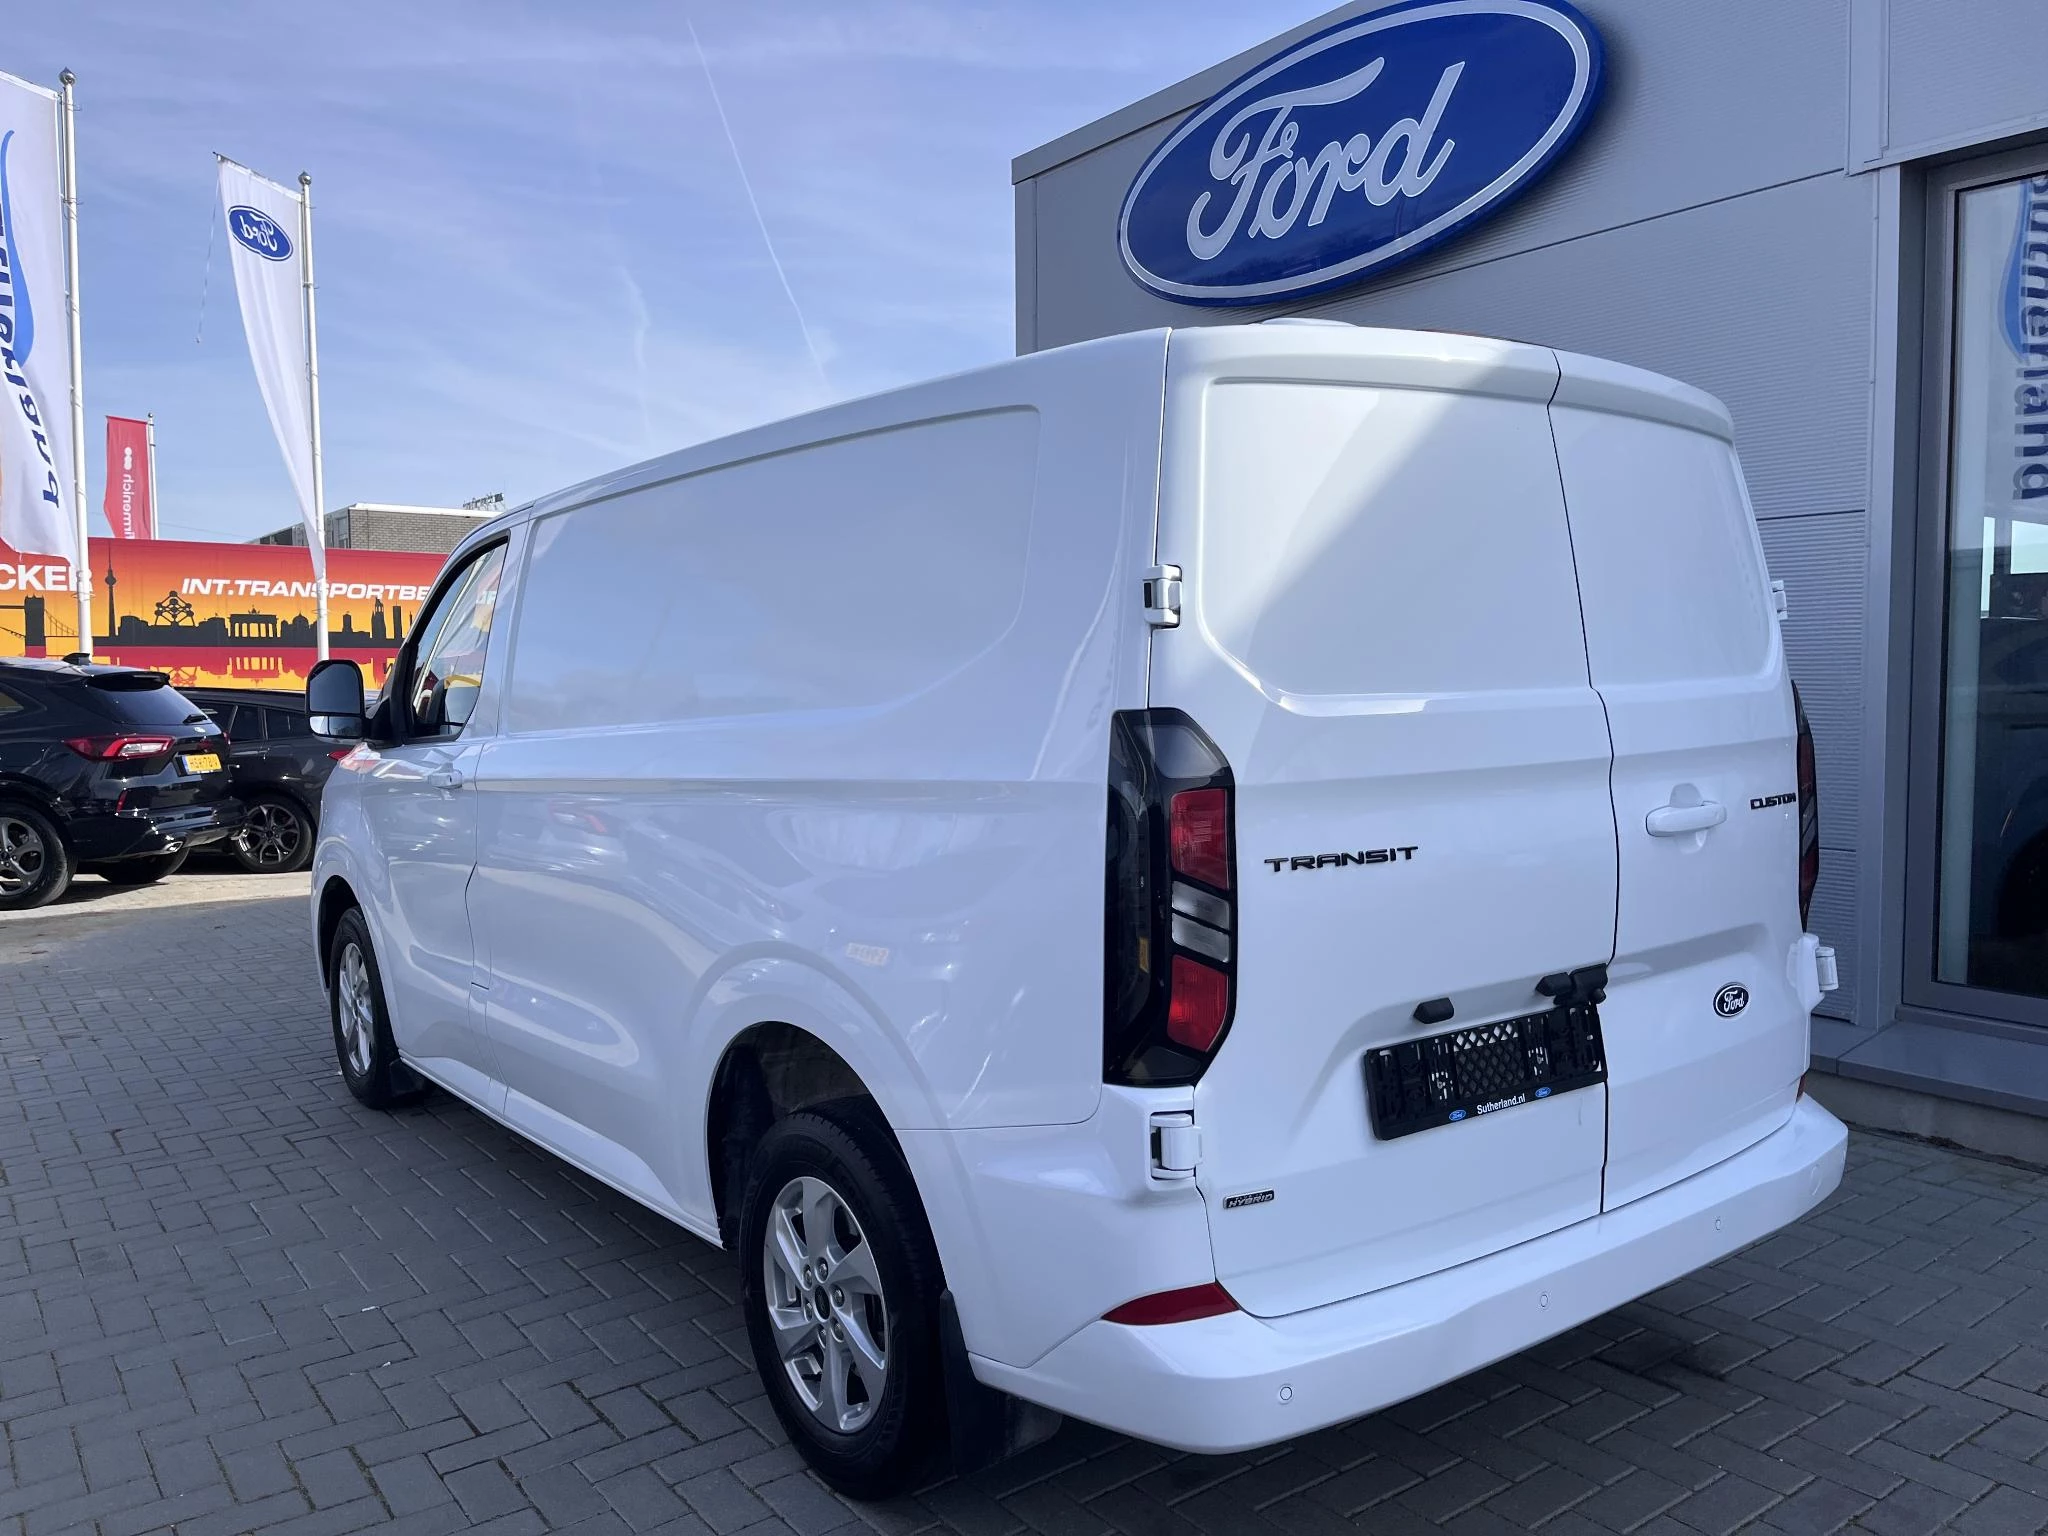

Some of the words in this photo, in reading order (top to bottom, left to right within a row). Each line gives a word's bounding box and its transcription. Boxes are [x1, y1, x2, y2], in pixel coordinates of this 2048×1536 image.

[1186, 56, 1466, 260] Ford
[1264, 846, 1419, 873] TRANSIT
[1723, 990, 1745, 1012] Ford
[1476, 1093, 1526, 1114] Sutherland.nl
